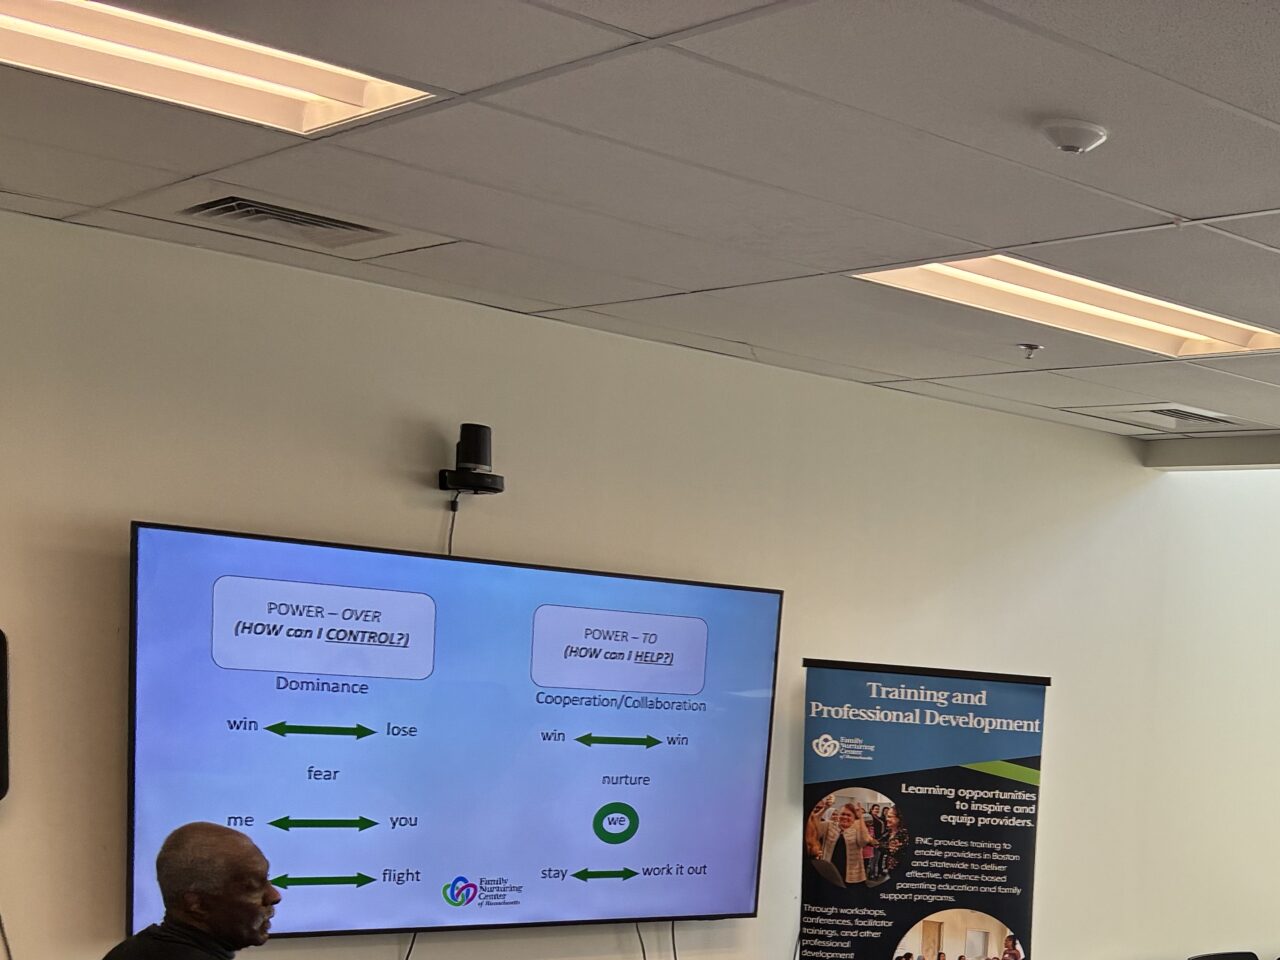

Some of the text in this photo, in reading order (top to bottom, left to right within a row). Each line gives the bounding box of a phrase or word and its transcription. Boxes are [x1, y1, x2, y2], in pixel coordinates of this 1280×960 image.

[267, 601, 325, 619] POWER
[341, 608, 382, 623] OVER
[234, 620, 410, 648] (HOW can I CONTROL?)
[584, 628, 629, 642] POWER
[642, 632, 658, 644] TO
[563, 645, 674, 666] (HOW can I HELP?)
[276, 676, 369, 694] Dominance
[536, 691, 707, 712] Cooperation/Collaboration
[866, 682, 987, 707] Training and
[809, 701, 1041, 733] Professional Development
[227, 717, 418, 737] win lose
[541, 729, 688, 746] win win
[307, 766, 340, 781] fear
[602, 774, 650, 786] nurture
[901, 783, 1037, 801] Learning opportunities
[955, 800, 1036, 814] to inspire and
[227, 815, 418, 830] me you
[607, 816, 626, 826] we
[940, 814, 1035, 827] equip providers.
[934, 838, 969, 848] provides
[970, 840, 1001, 851] training
[1003, 842, 1013, 850] to
[944, 850, 982, 859] providers
[983, 851, 991, 859] in
[992, 852, 1020, 861] Boston
[541, 864, 707, 881] stay work it out
[971, 862, 979, 870] to
[980, 863, 1008, 871] deliver
[382, 868, 421, 886] flight
[937, 884, 978, 892] education
[980, 885, 997, 893] and
[803, 903, 838, 915] Through
[840, 929, 858, 937] and
[859, 930, 881, 938] other
[802, 938, 851, 948] professional
[801, 949, 855, 959] development
